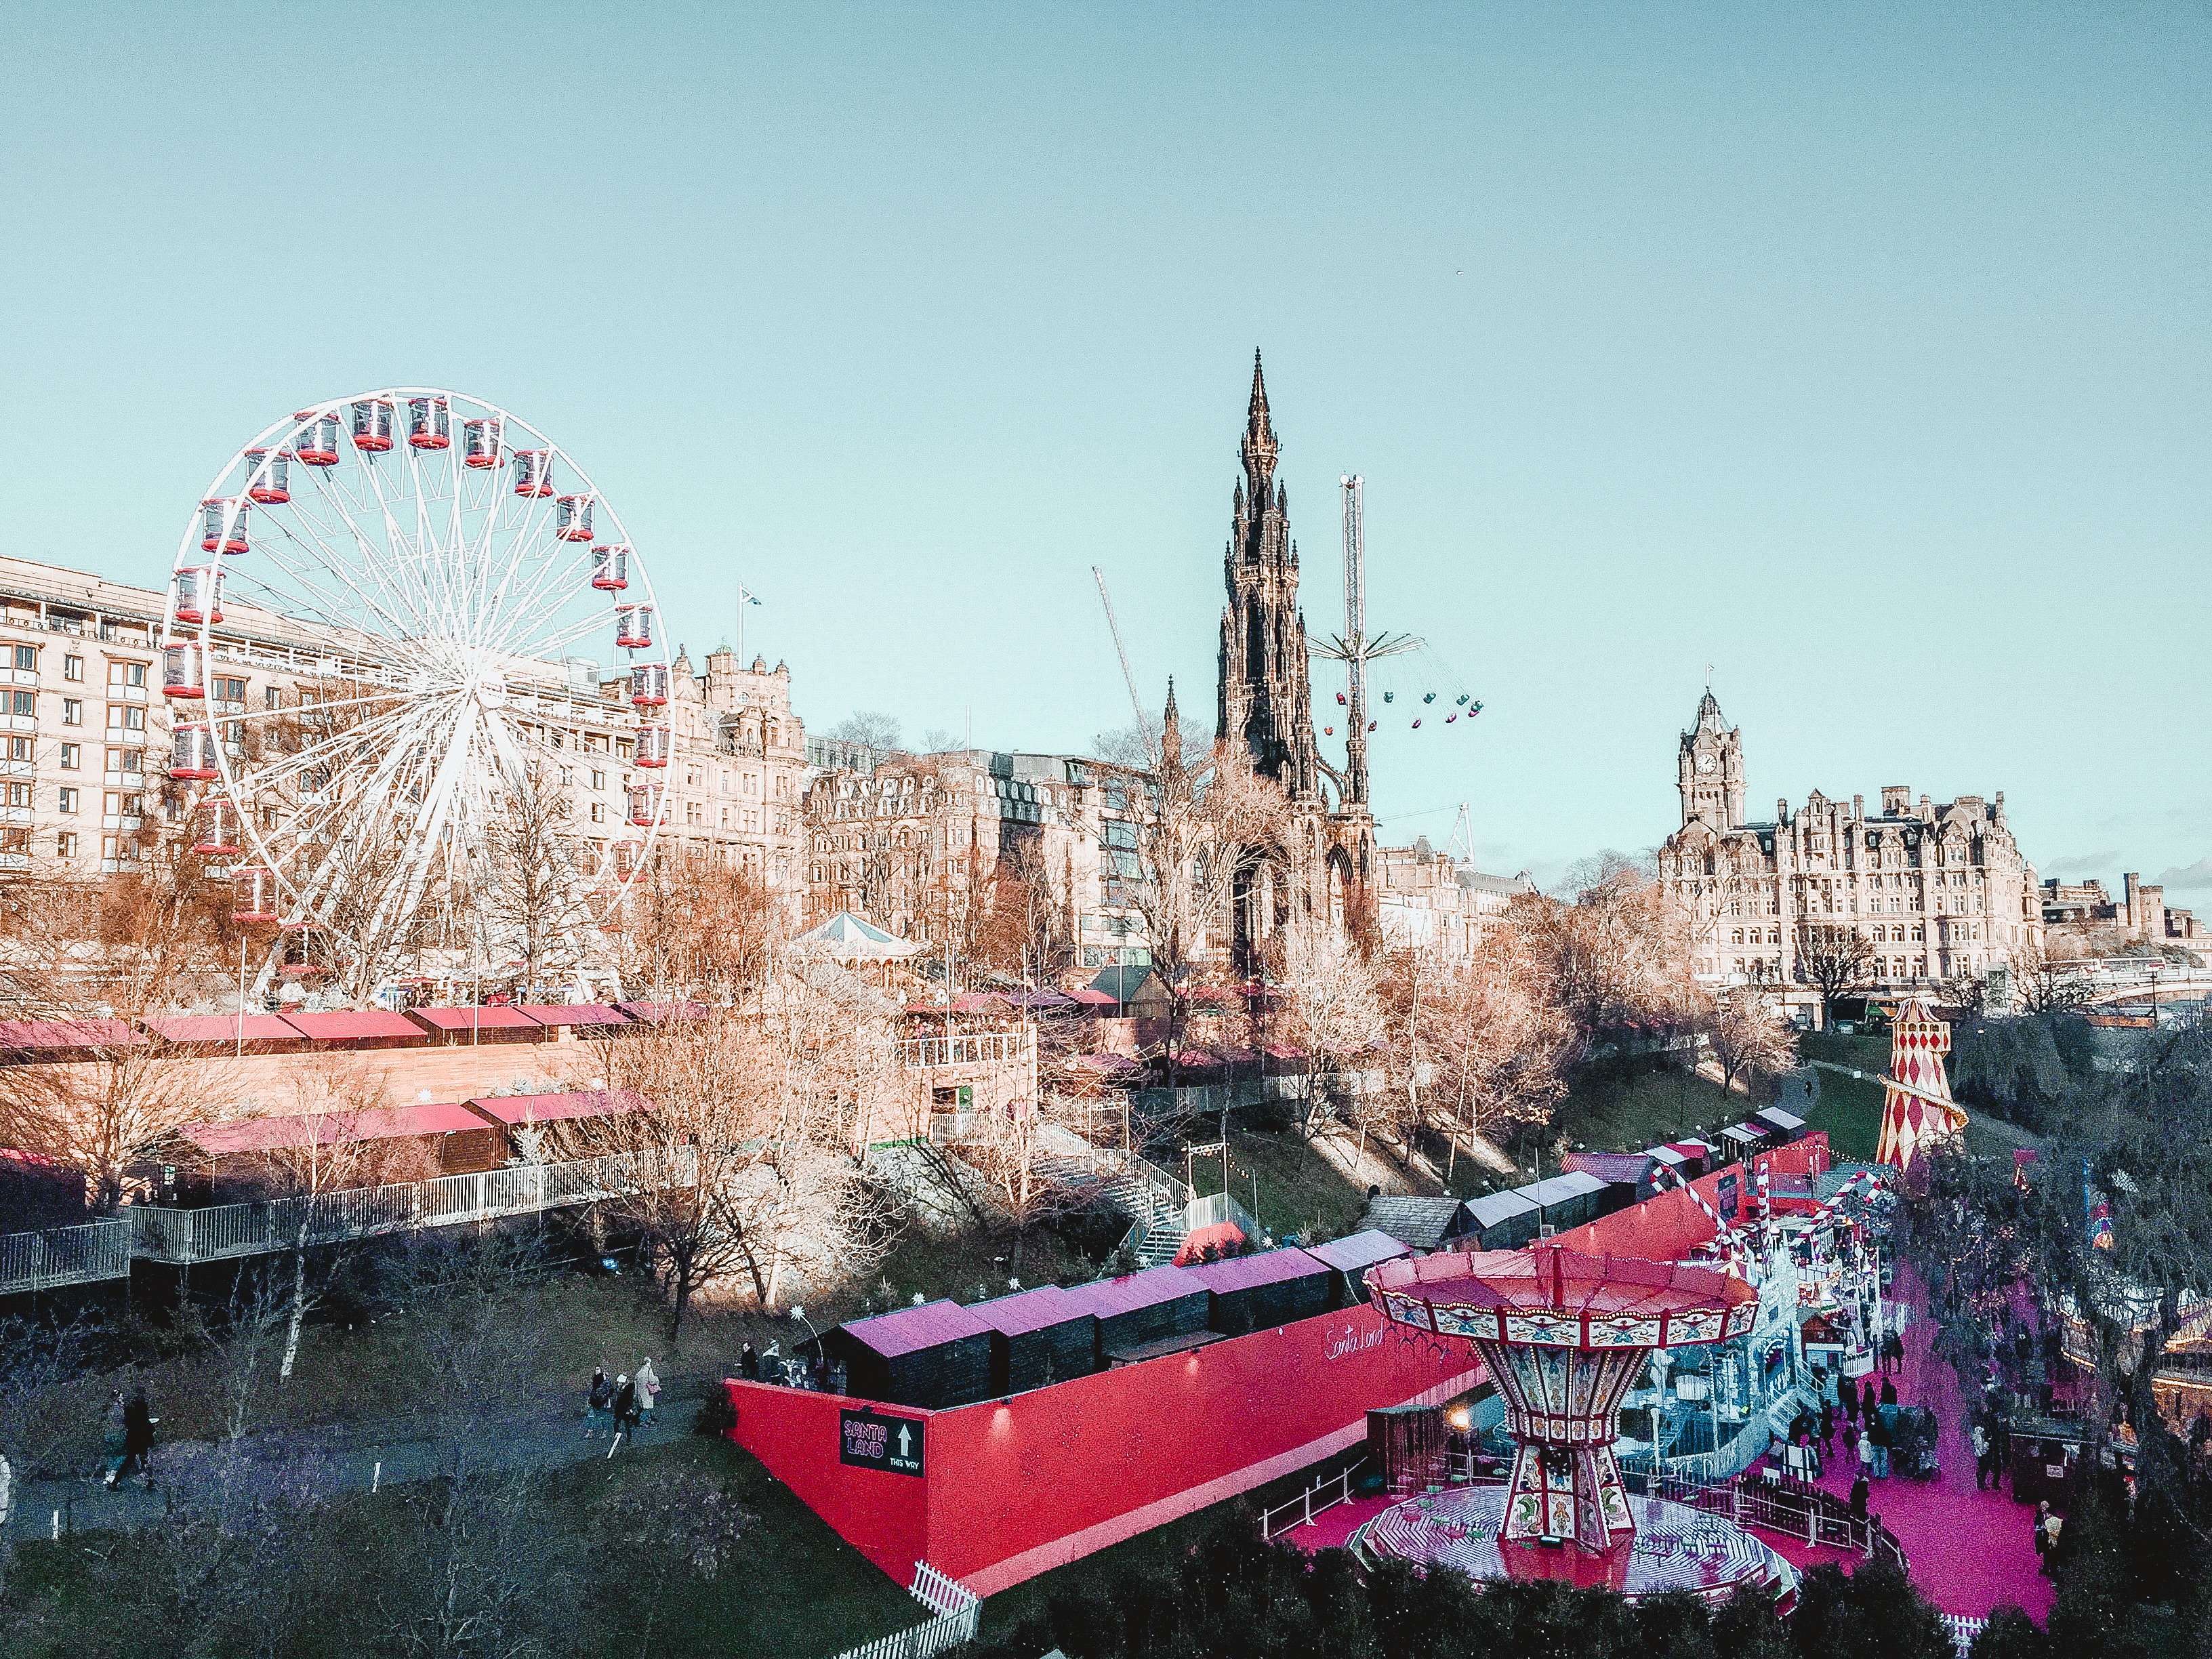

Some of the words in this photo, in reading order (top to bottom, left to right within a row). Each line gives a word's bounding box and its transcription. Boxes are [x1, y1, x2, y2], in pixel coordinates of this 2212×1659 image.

[844, 1420, 887, 1442] SANTA
[847, 1437, 884, 1458] LAND
[889, 1457, 903, 1467] THIS
[905, 1460, 920, 1470] WAY
